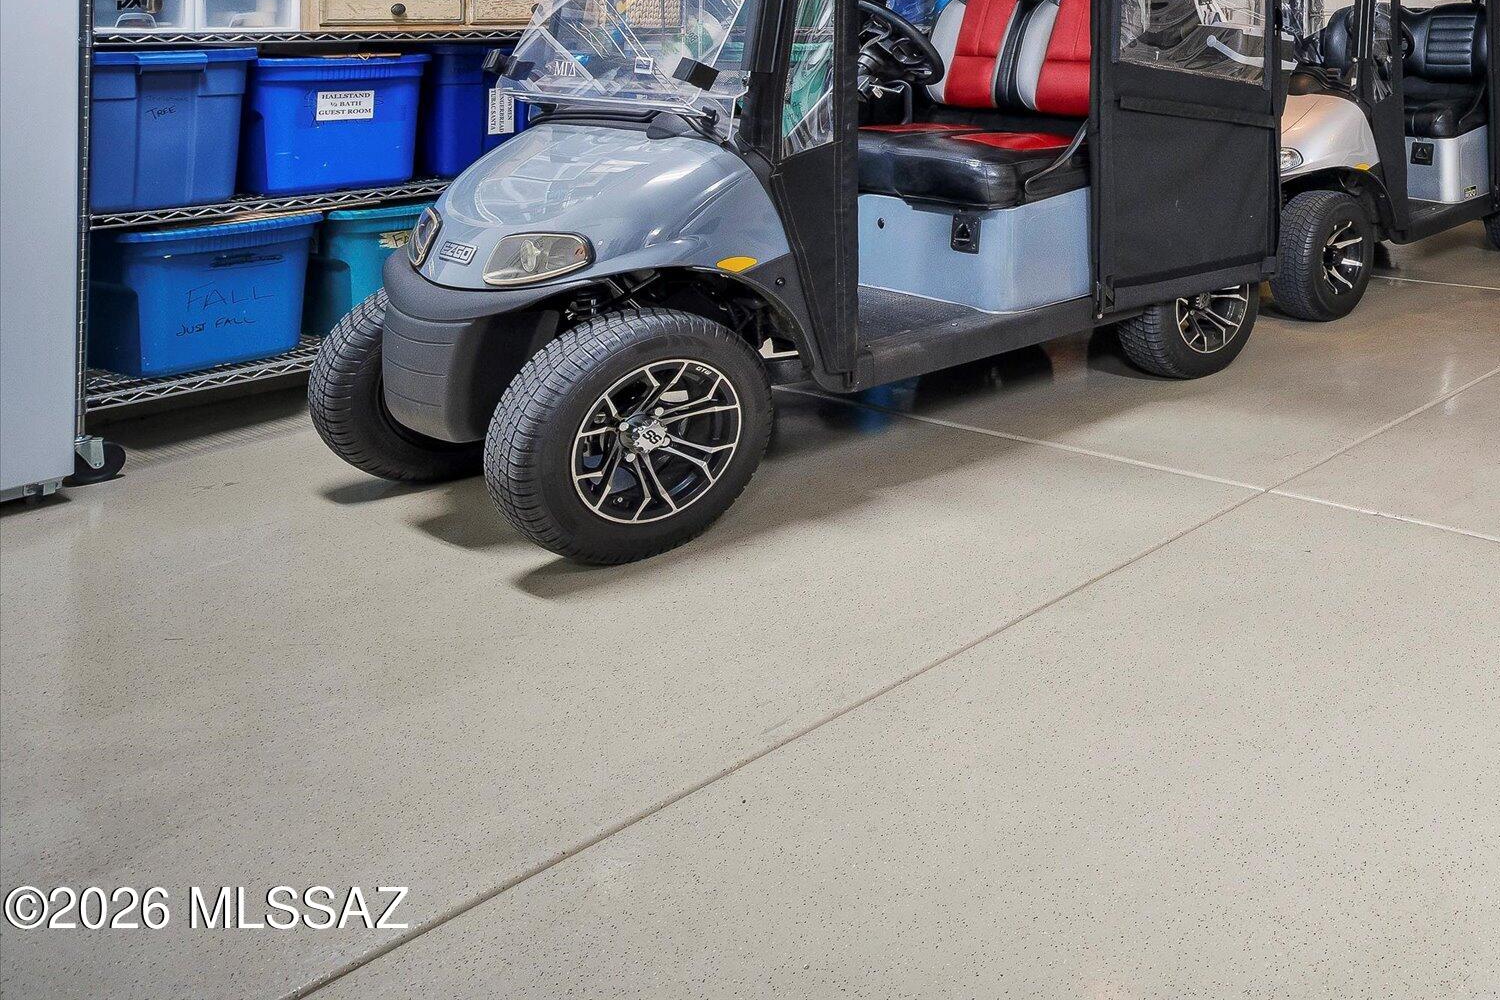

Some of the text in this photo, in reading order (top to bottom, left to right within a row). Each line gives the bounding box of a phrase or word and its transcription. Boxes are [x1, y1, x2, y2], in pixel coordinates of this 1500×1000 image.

[321, 92, 371, 100] HALLSTAND
[185, 280, 275, 312] FALL
[176, 316, 257, 337] JUST FALL
